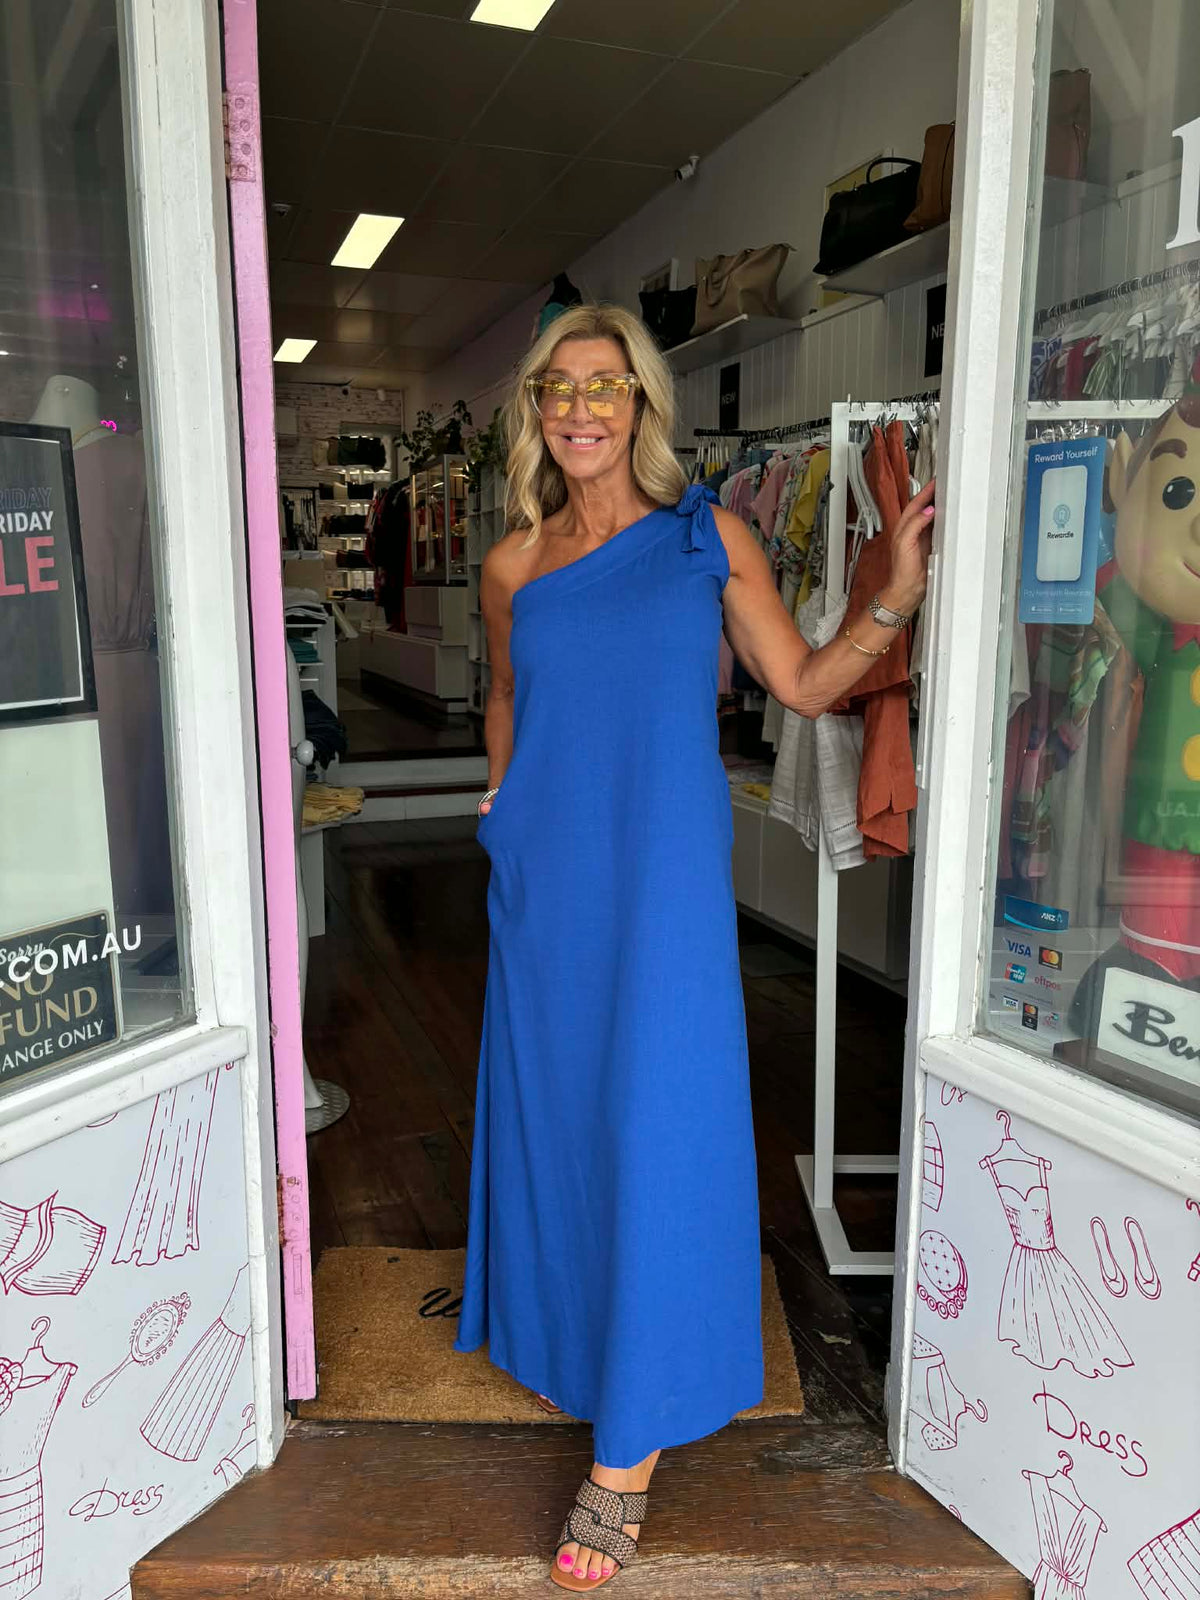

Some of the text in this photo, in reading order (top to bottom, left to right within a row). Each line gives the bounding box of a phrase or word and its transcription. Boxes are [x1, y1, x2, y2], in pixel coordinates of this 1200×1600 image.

[1035, 446, 1098, 463] Reward Yourself
[1041, 912, 1056, 922] ANZ
[1003, 937, 1032, 958] VISA
[57, 1019, 104, 1049] ONLY
[69, 1477, 165, 1522] Dress
